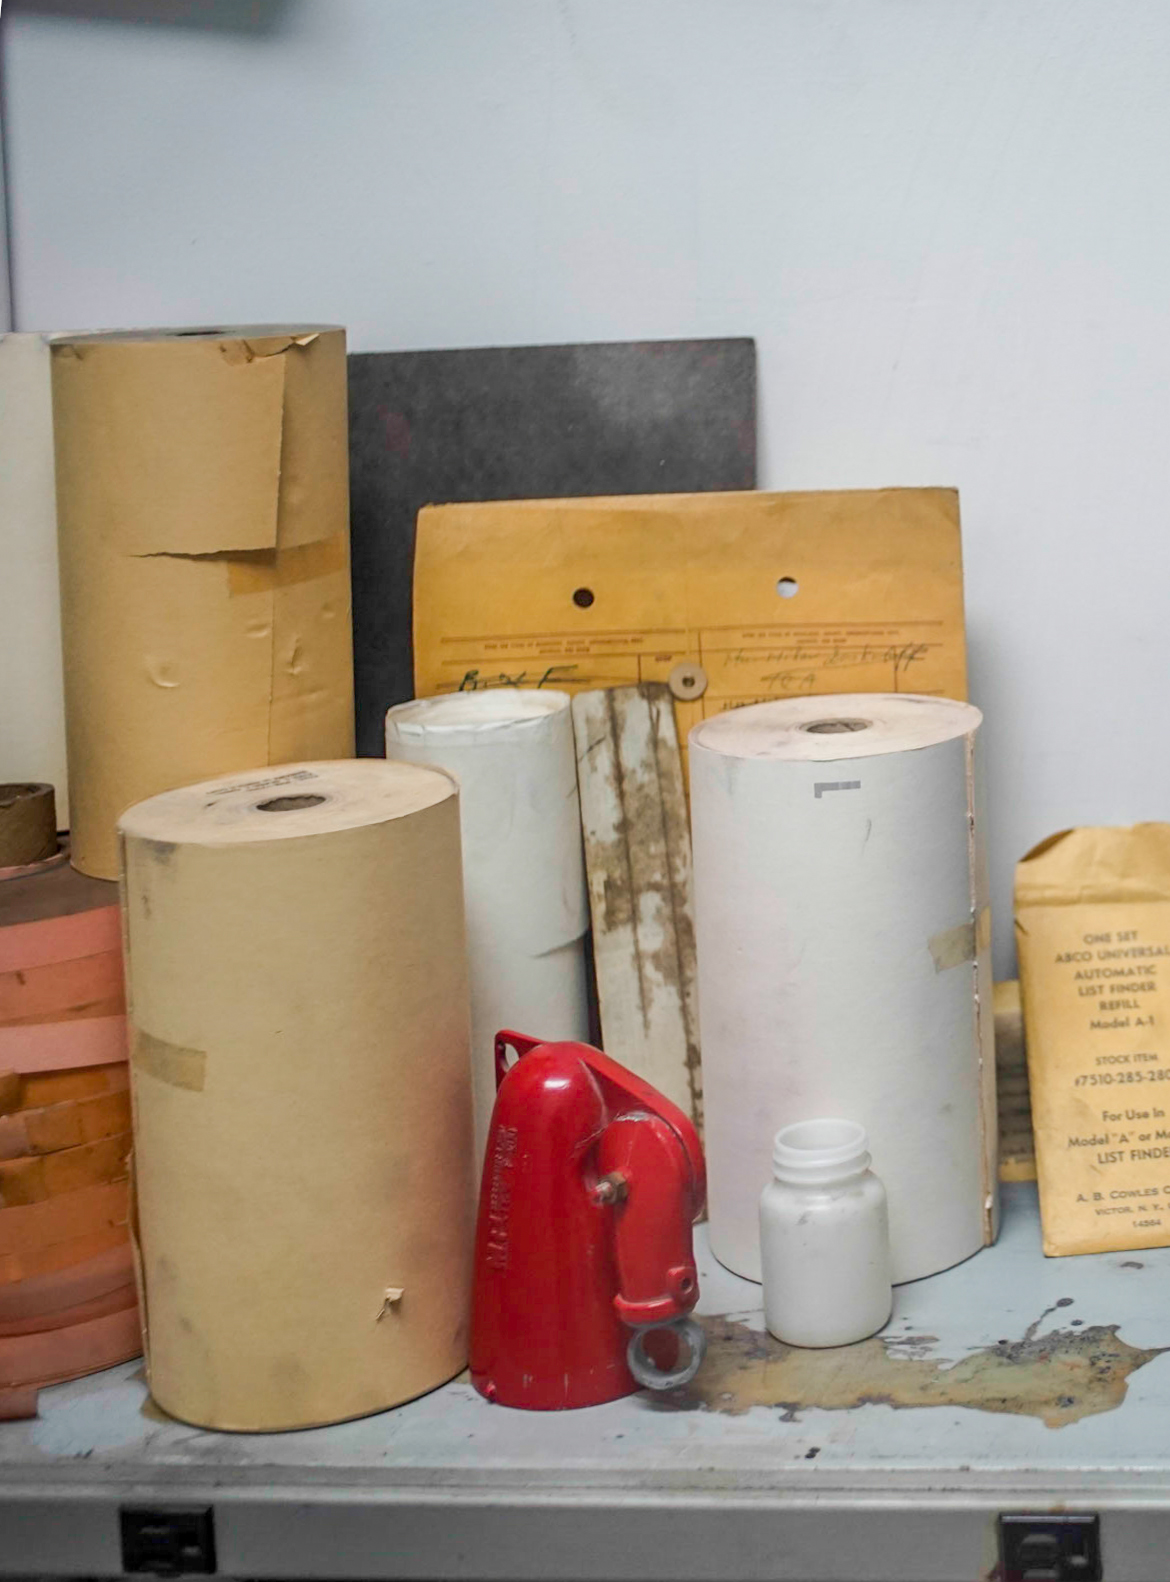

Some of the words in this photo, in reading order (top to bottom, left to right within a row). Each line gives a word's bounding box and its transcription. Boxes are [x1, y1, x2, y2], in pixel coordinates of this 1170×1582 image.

[1083, 932, 1112, 945] ONE
[1116, 930, 1138, 942] SET
[1054, 951, 1093, 964] ABCO
[1074, 964, 1158, 981] AUTOMATIC
[1078, 984, 1105, 998] LIST
[1109, 981, 1157, 995] FINDER
[1098, 999, 1141, 1012] REFILL
[1089, 1016, 1130, 1031] Model
[1135, 1015, 1156, 1027] A-1
[1095, 1053, 1130, 1066] STOCK
[1133, 1052, 1159, 1063] ITEM
[1102, 1110, 1122, 1122] For
[1125, 1108, 1150, 1121] Use
[1068, 1133, 1109, 1148] Model
[1111, 1130, 1136, 1144] "A"
[1138, 1133, 1152, 1142] or
[1097, 1150, 1125, 1165] LIST
[1076, 1193, 1088, 1203] A.
[1093, 1191, 1105, 1202] B.
[1109, 1187, 1159, 1200] COWLES
